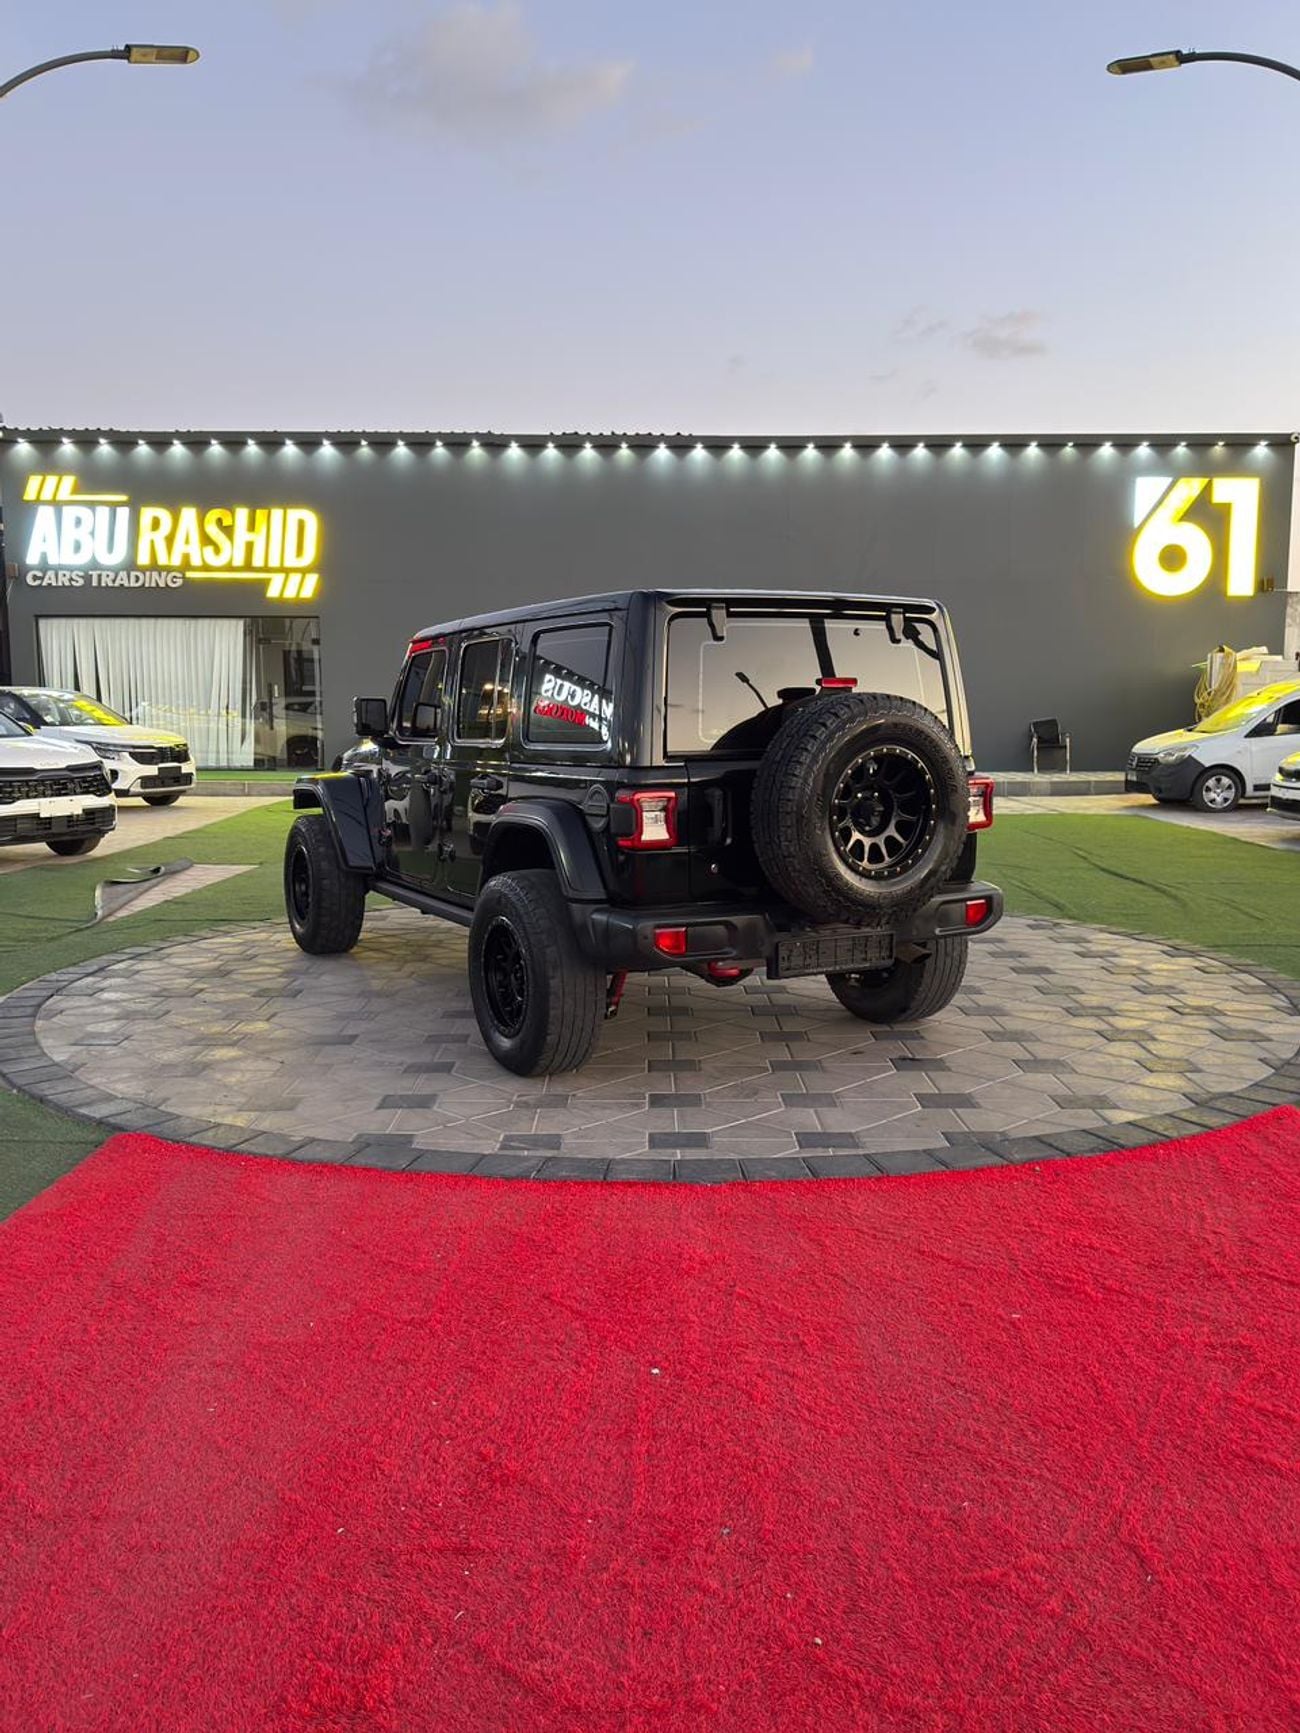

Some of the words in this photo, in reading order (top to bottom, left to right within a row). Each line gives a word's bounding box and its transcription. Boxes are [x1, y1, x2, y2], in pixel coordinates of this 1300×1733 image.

[25, 505, 130, 565] ABU
[136, 507, 318, 567] RASHID
[1132, 477, 1260, 597] 61
[25, 570, 85, 588] CARS
[89, 570, 184, 588] TRADING
